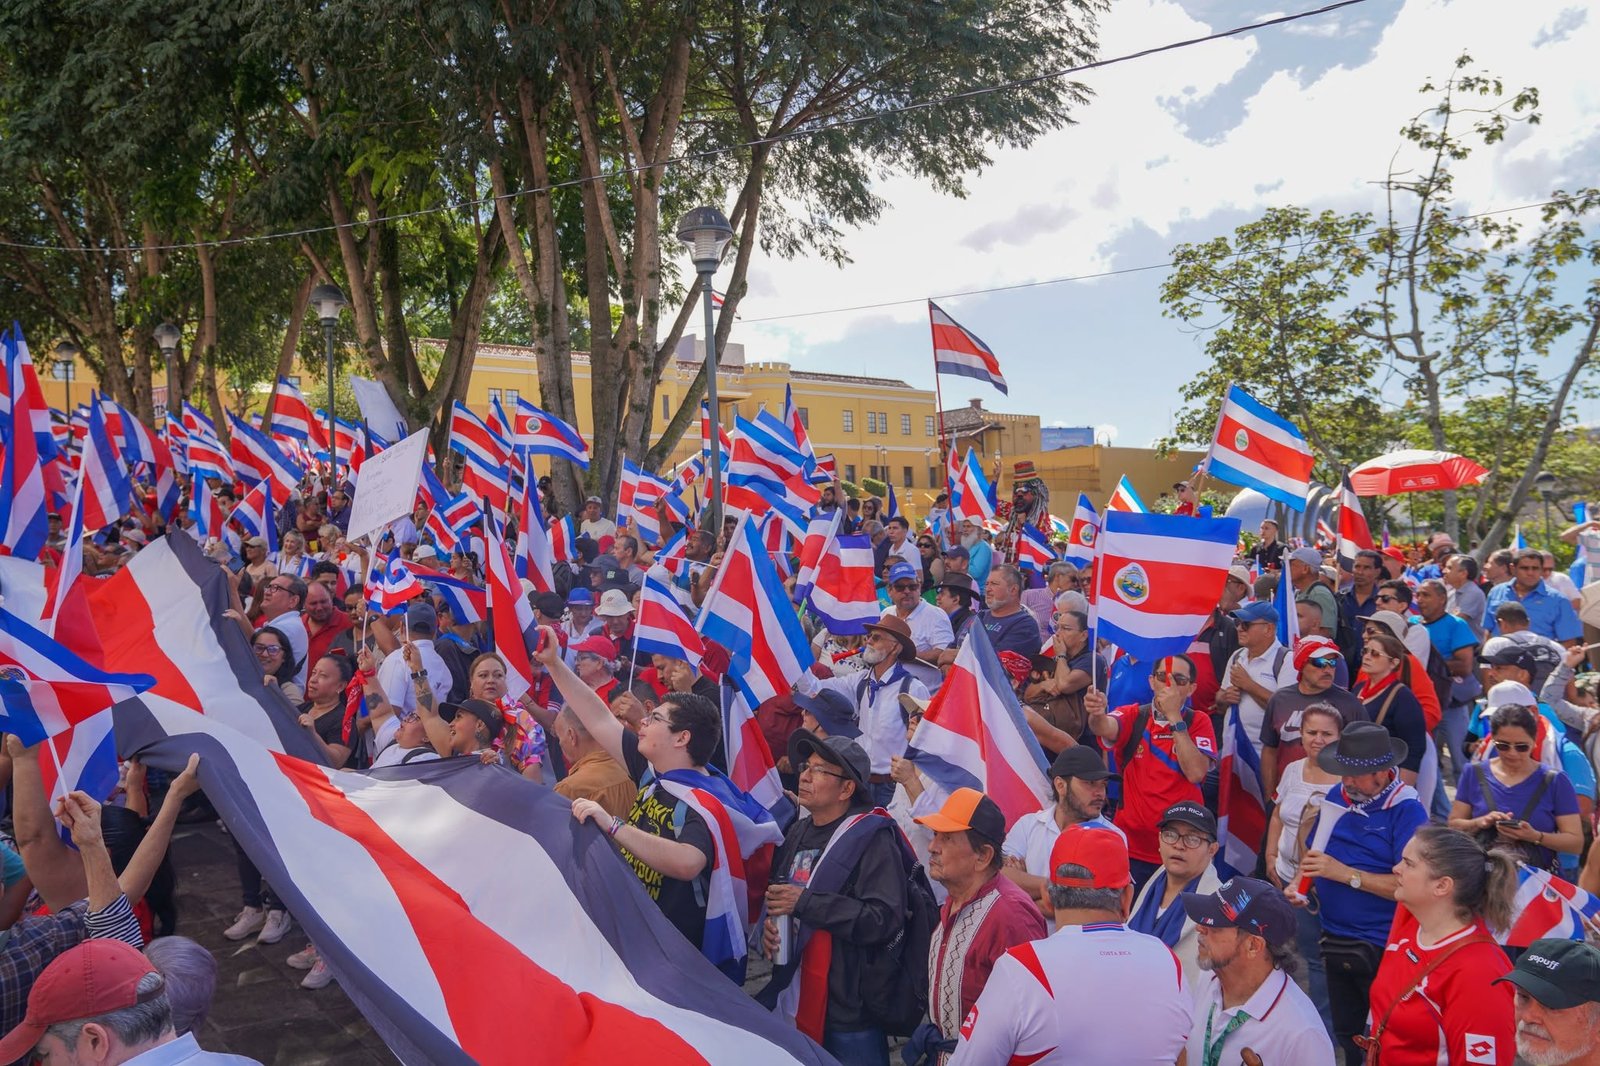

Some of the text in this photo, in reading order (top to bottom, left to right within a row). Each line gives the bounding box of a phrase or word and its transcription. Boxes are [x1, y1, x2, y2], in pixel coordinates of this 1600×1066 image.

[1167, 806, 1205, 818] COSTA RICA
[1527, 954, 1560, 970] gopuff
